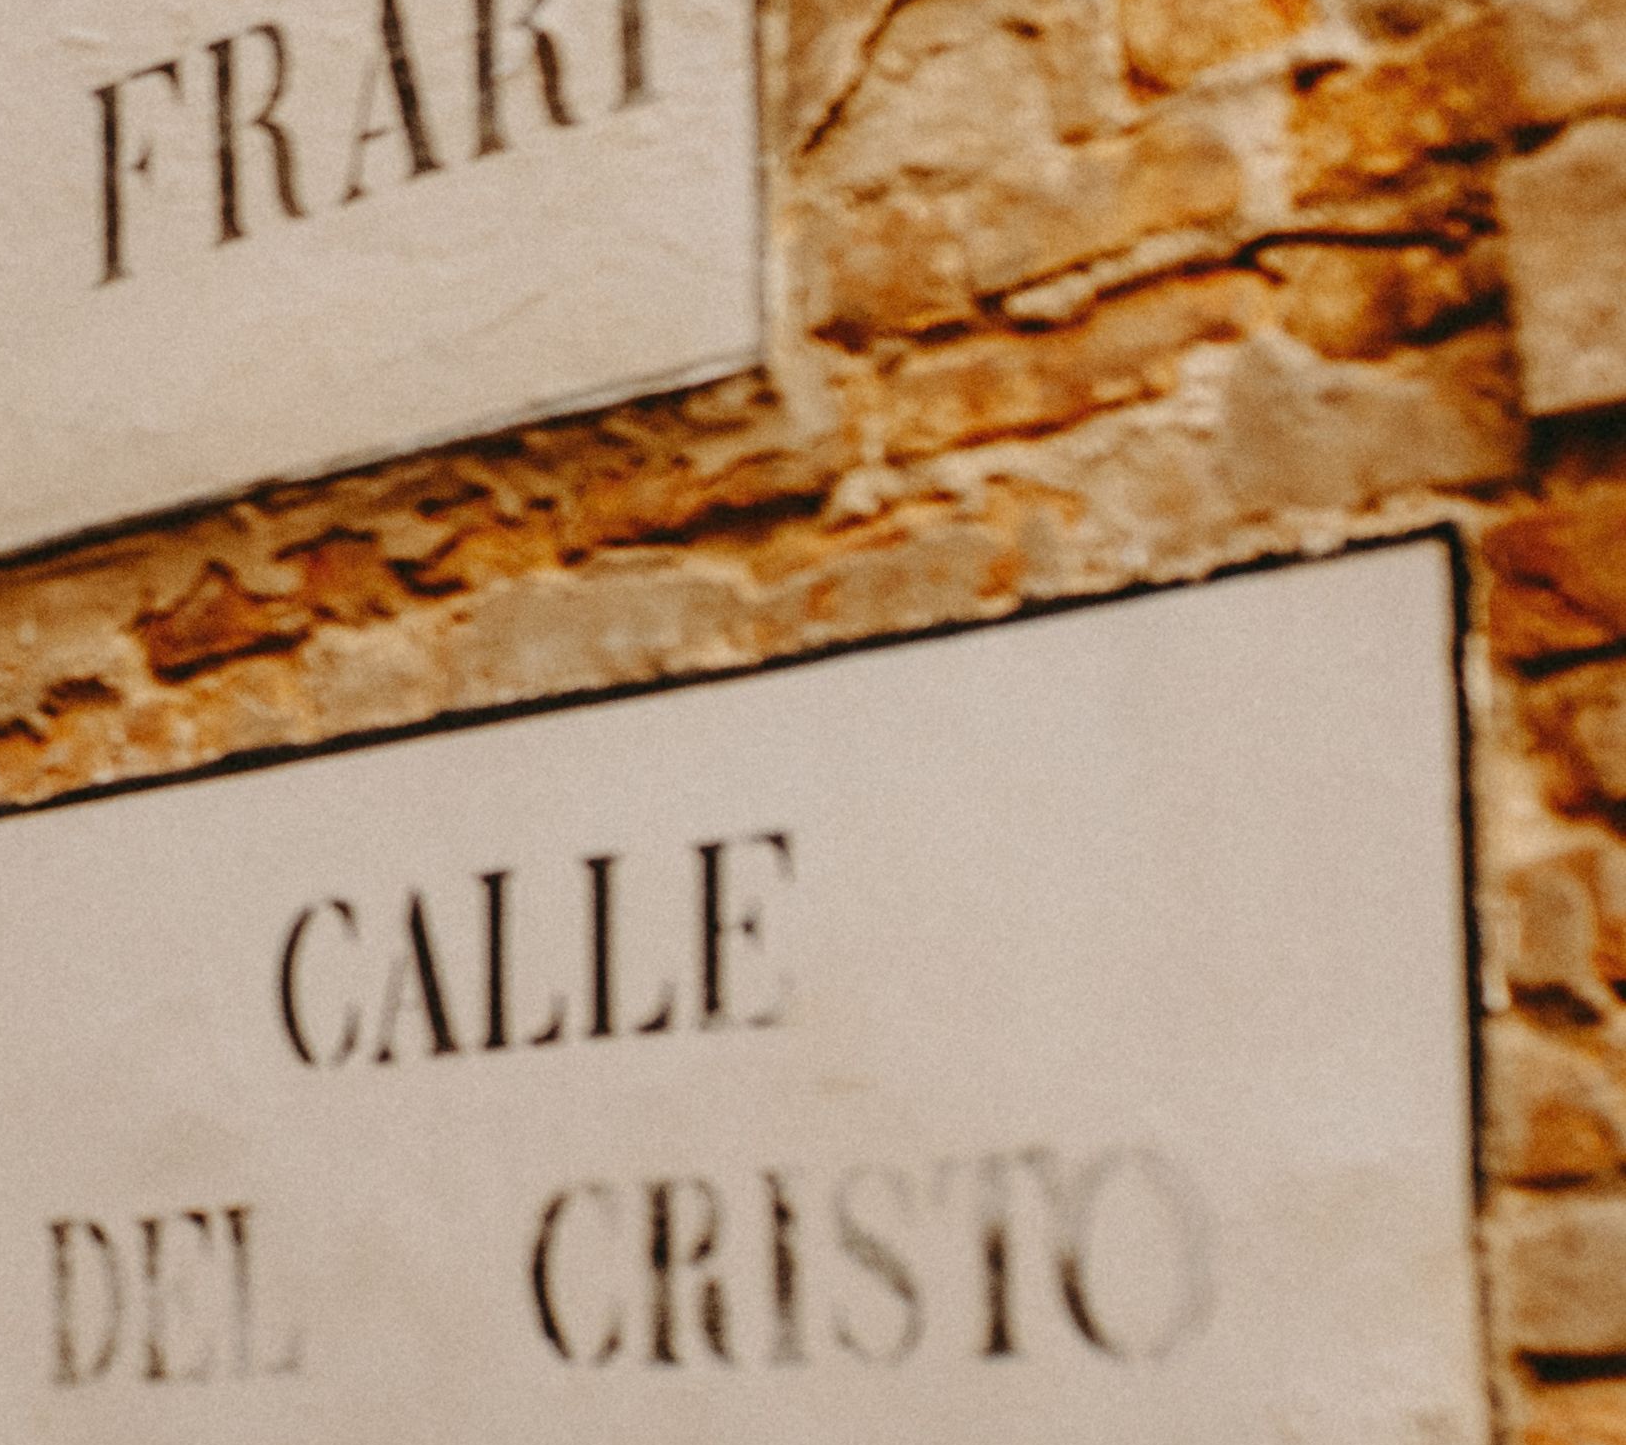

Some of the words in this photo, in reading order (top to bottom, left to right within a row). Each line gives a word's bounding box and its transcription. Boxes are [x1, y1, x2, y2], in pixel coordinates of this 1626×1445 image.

[277, 832, 799, 1068] CALLE
[47, 1204, 305, 1392] DEL
[529, 1143, 1215, 1368] CRISTO
